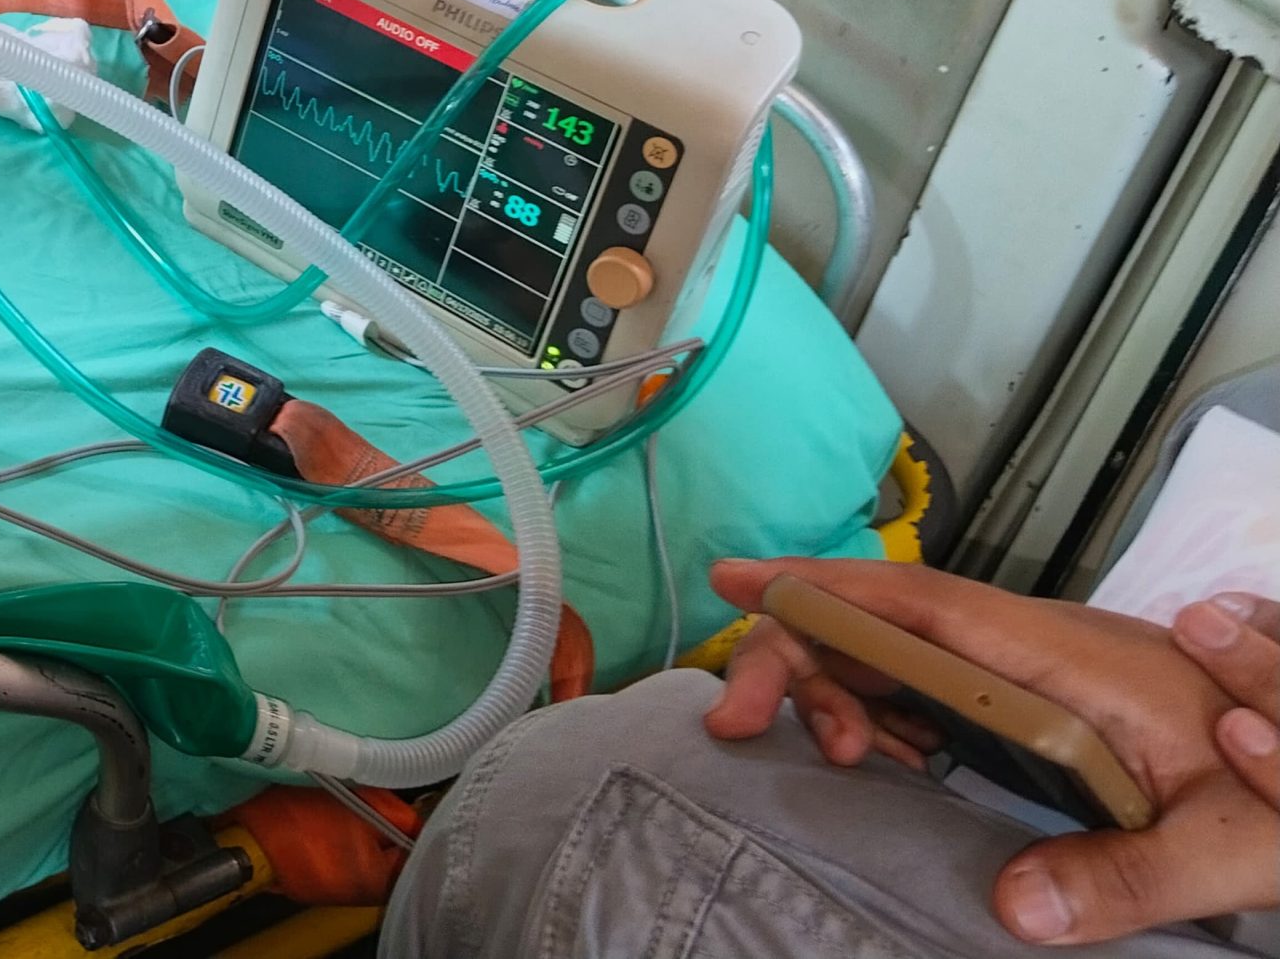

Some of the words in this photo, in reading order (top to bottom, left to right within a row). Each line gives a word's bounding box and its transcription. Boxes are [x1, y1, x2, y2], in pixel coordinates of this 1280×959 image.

[376, 17, 414, 42] AUDIO
[415, 35, 440, 52] OFF
[542, 107, 596, 146] 143
[504, 195, 542, 227] 88
